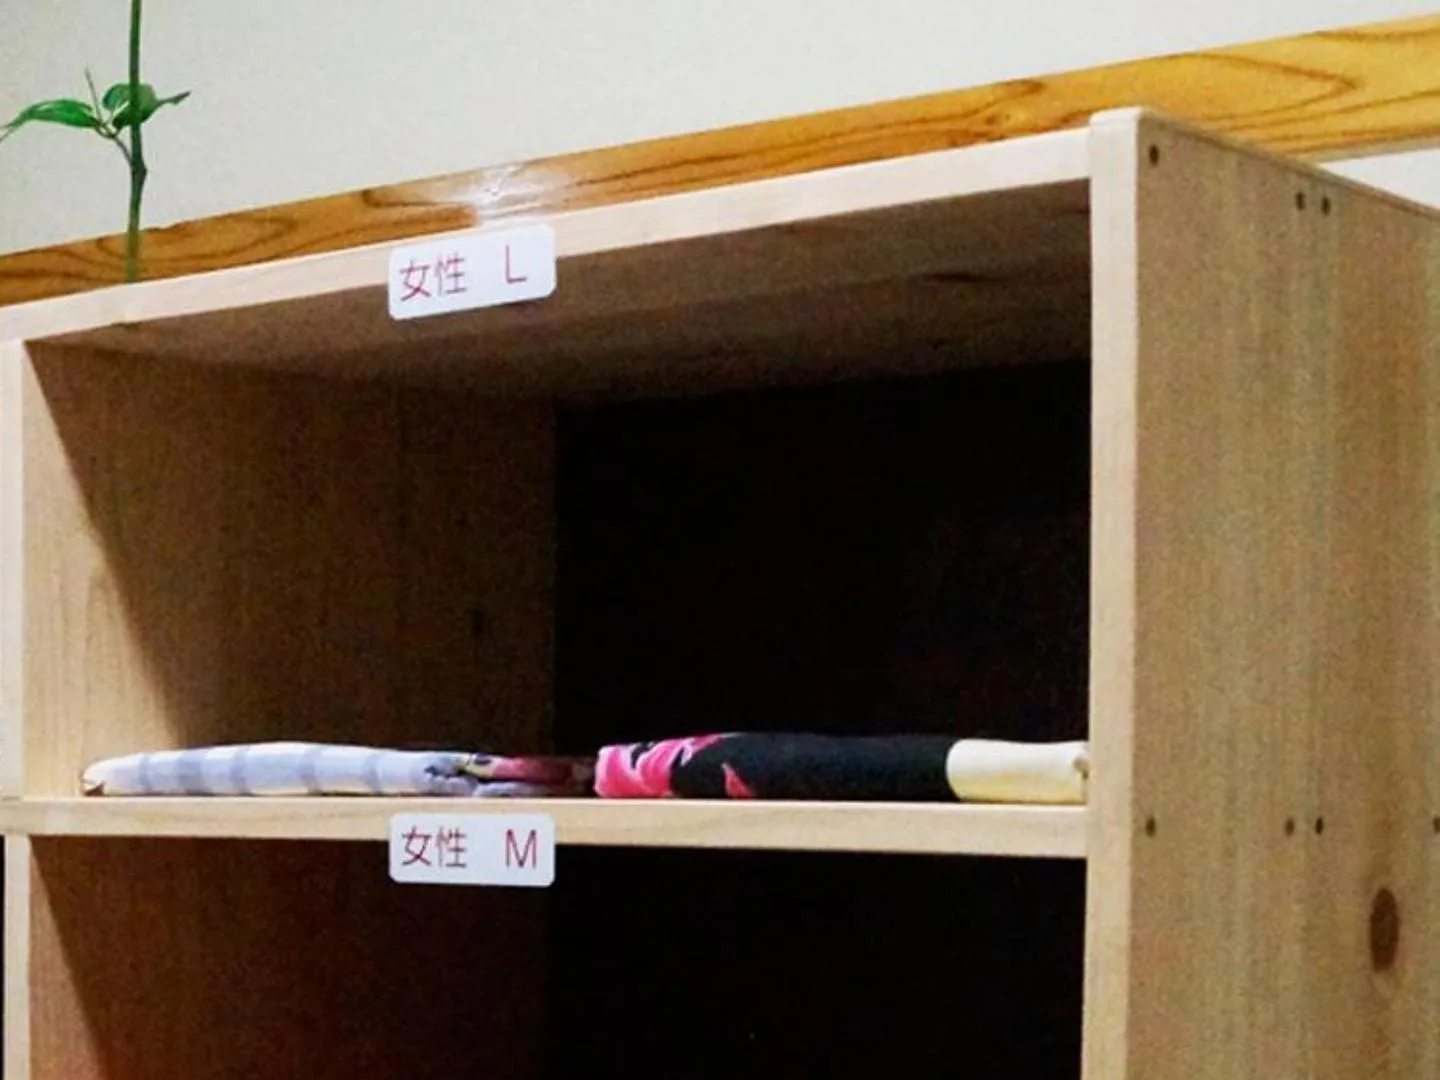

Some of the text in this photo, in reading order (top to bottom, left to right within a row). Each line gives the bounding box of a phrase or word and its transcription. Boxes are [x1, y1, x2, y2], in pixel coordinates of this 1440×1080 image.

[399, 244, 527, 302] 女性 L
[401, 825, 537, 869] 女性 M
